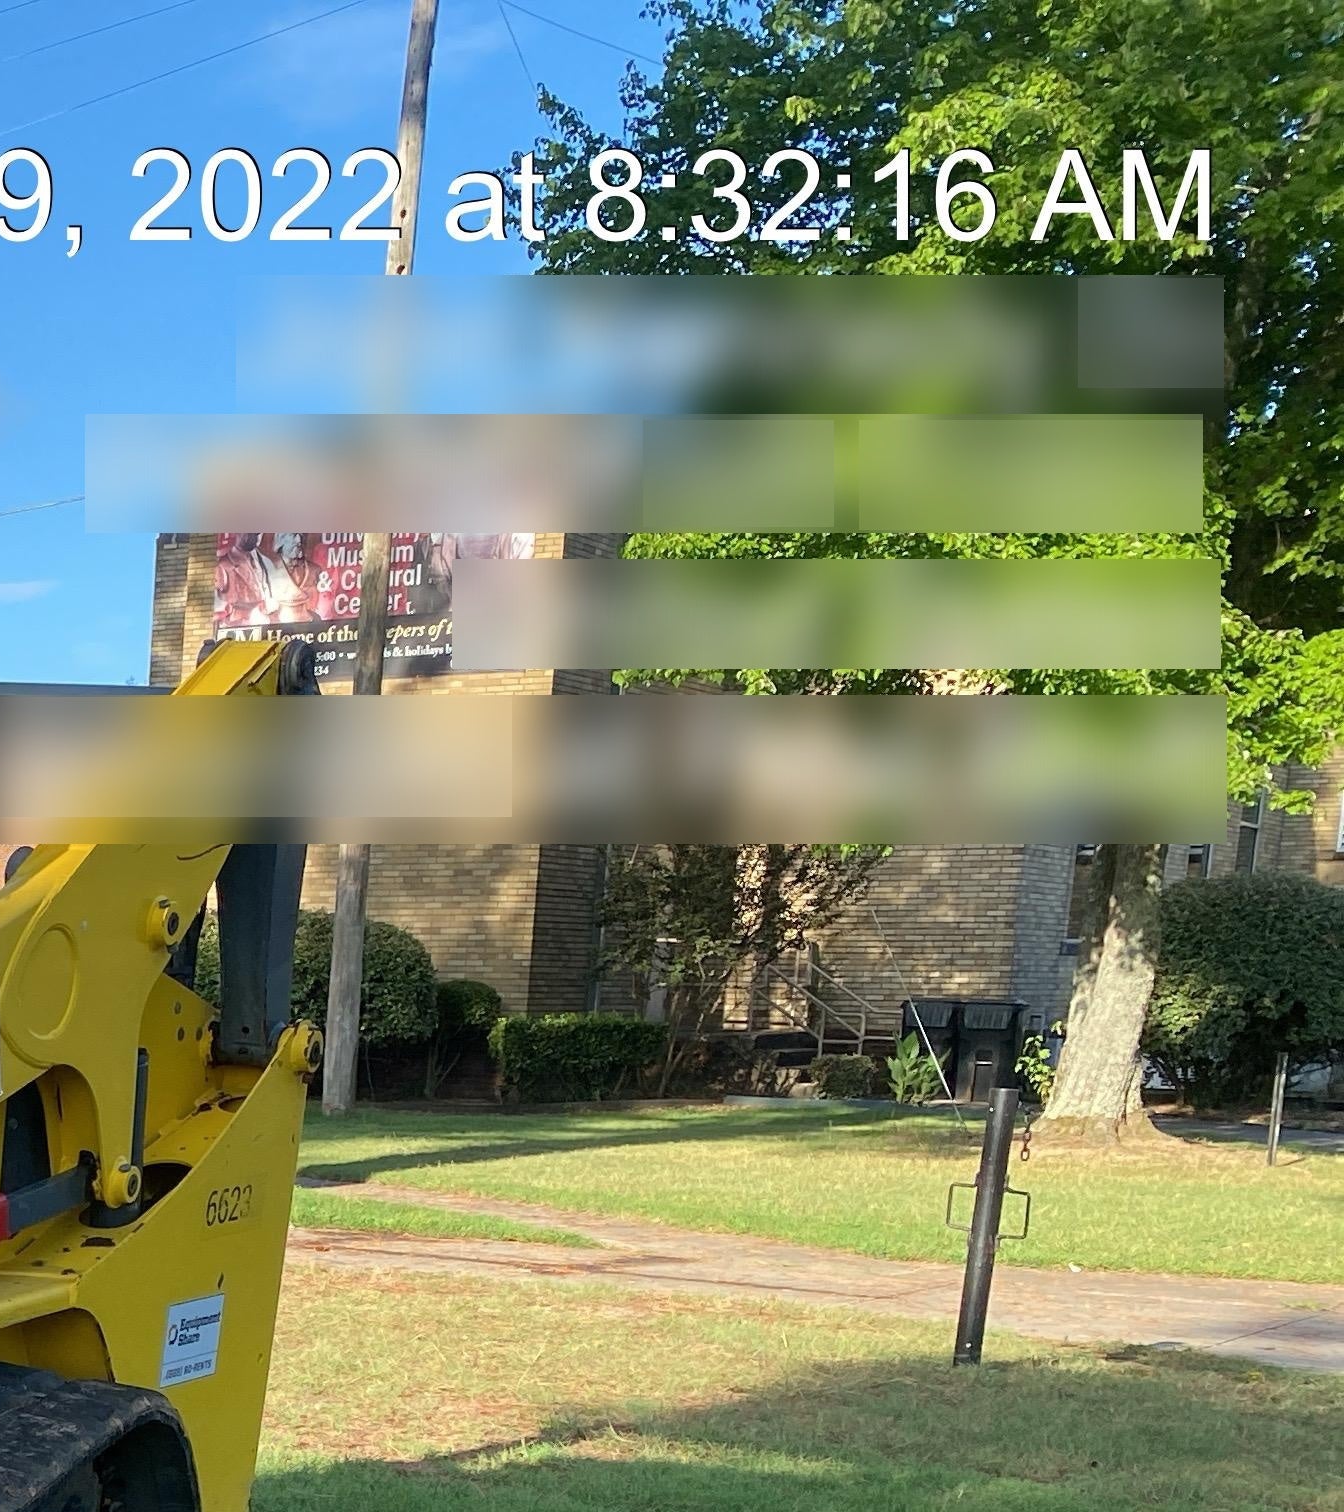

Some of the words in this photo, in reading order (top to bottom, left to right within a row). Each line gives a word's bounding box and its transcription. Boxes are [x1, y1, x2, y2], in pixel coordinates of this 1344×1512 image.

[326, 545, 414, 568] Musm
[316, 571, 332, 593] &
[341, 564, 421, 590] Cral
[334, 593, 403, 616] Cer
[317, 625, 336, 643] of
[385, 624, 425, 644] epers
[428, 618, 448, 642] of
[405, 644, 444, 658] holidays
